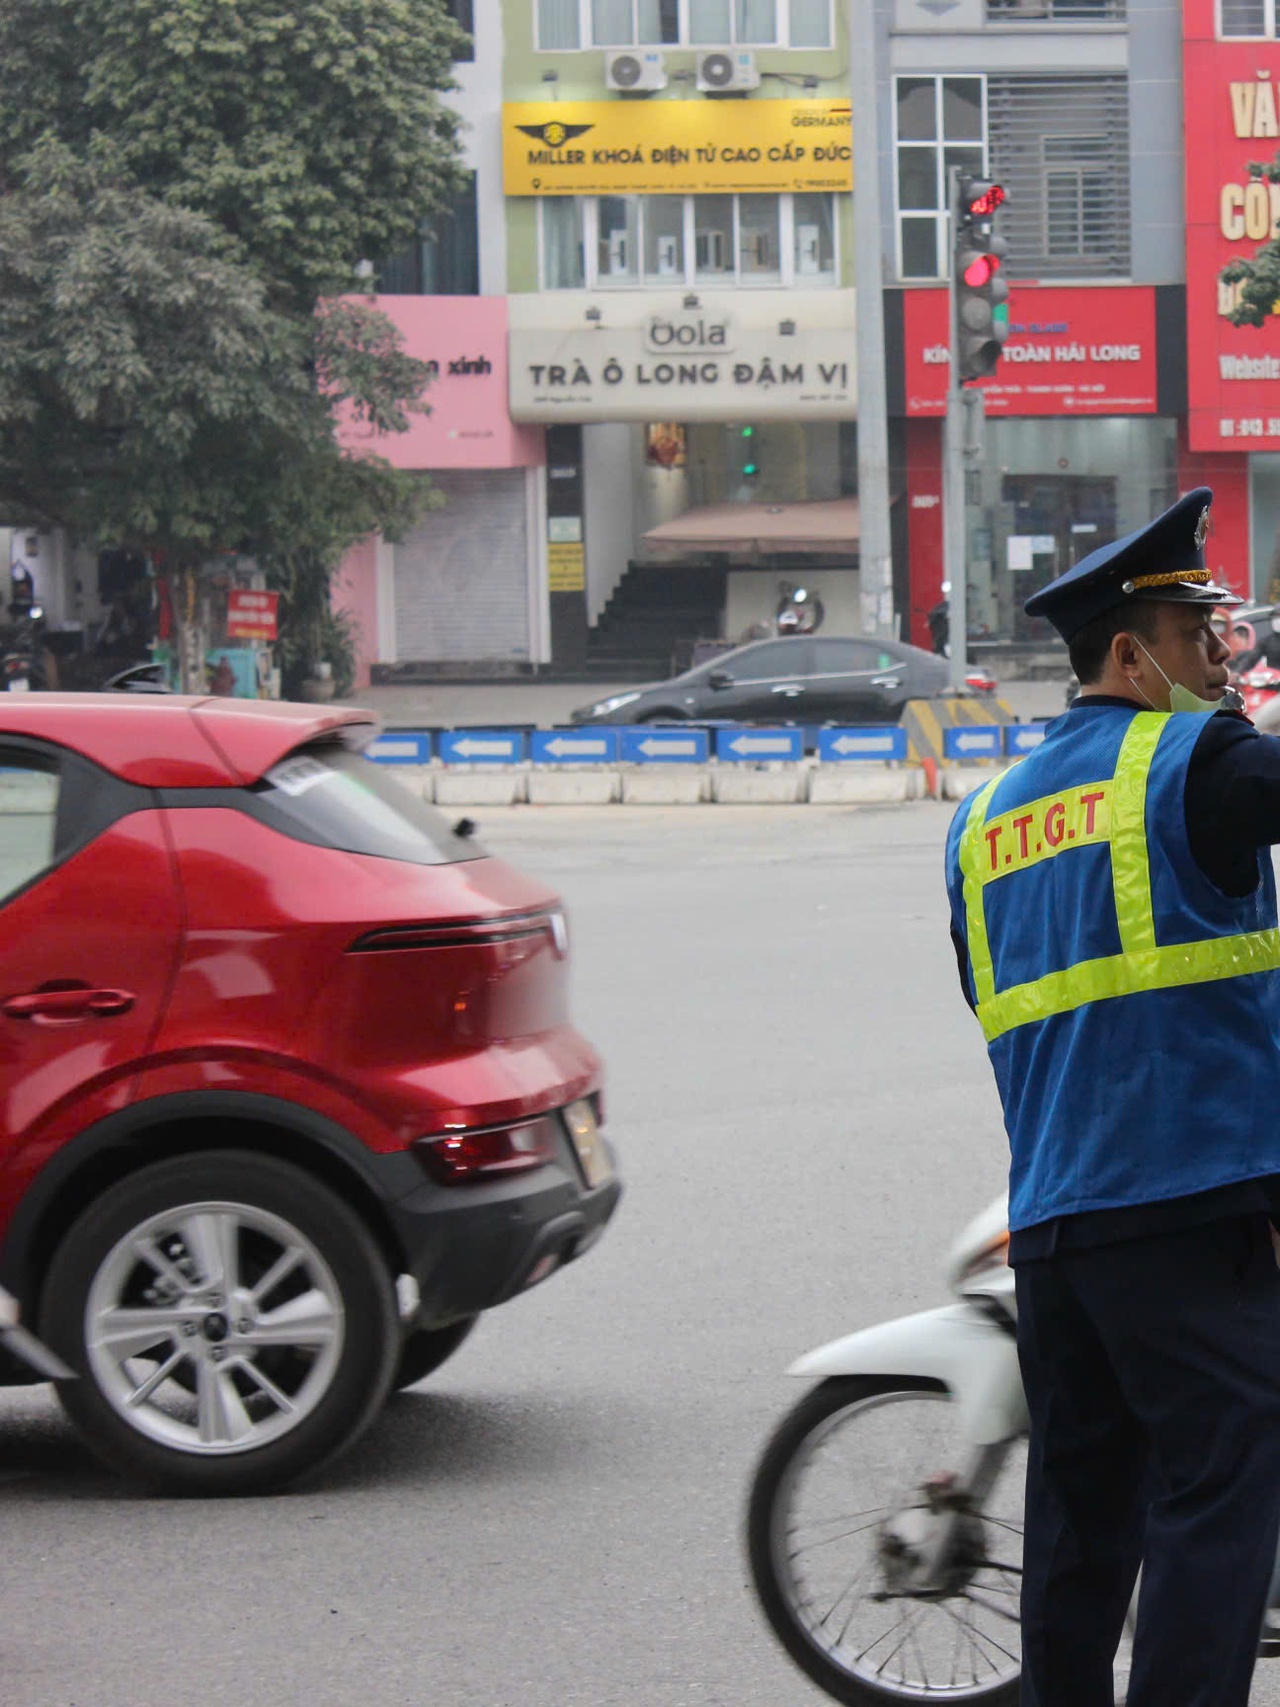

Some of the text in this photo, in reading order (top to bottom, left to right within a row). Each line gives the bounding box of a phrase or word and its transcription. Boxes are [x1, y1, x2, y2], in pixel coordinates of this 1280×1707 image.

[528, 140, 852, 167] MILLER KHOÁ ĐIỆN TỬ CAO CẤP ĐỨC
[1003, 343, 1050, 363] TOÀN
[1090, 345, 1142, 362] LONG
[529, 357, 848, 391] TRÀ Ô LONG ĐẬM VỊ
[985, 791, 1105, 871] T.T.G.T
